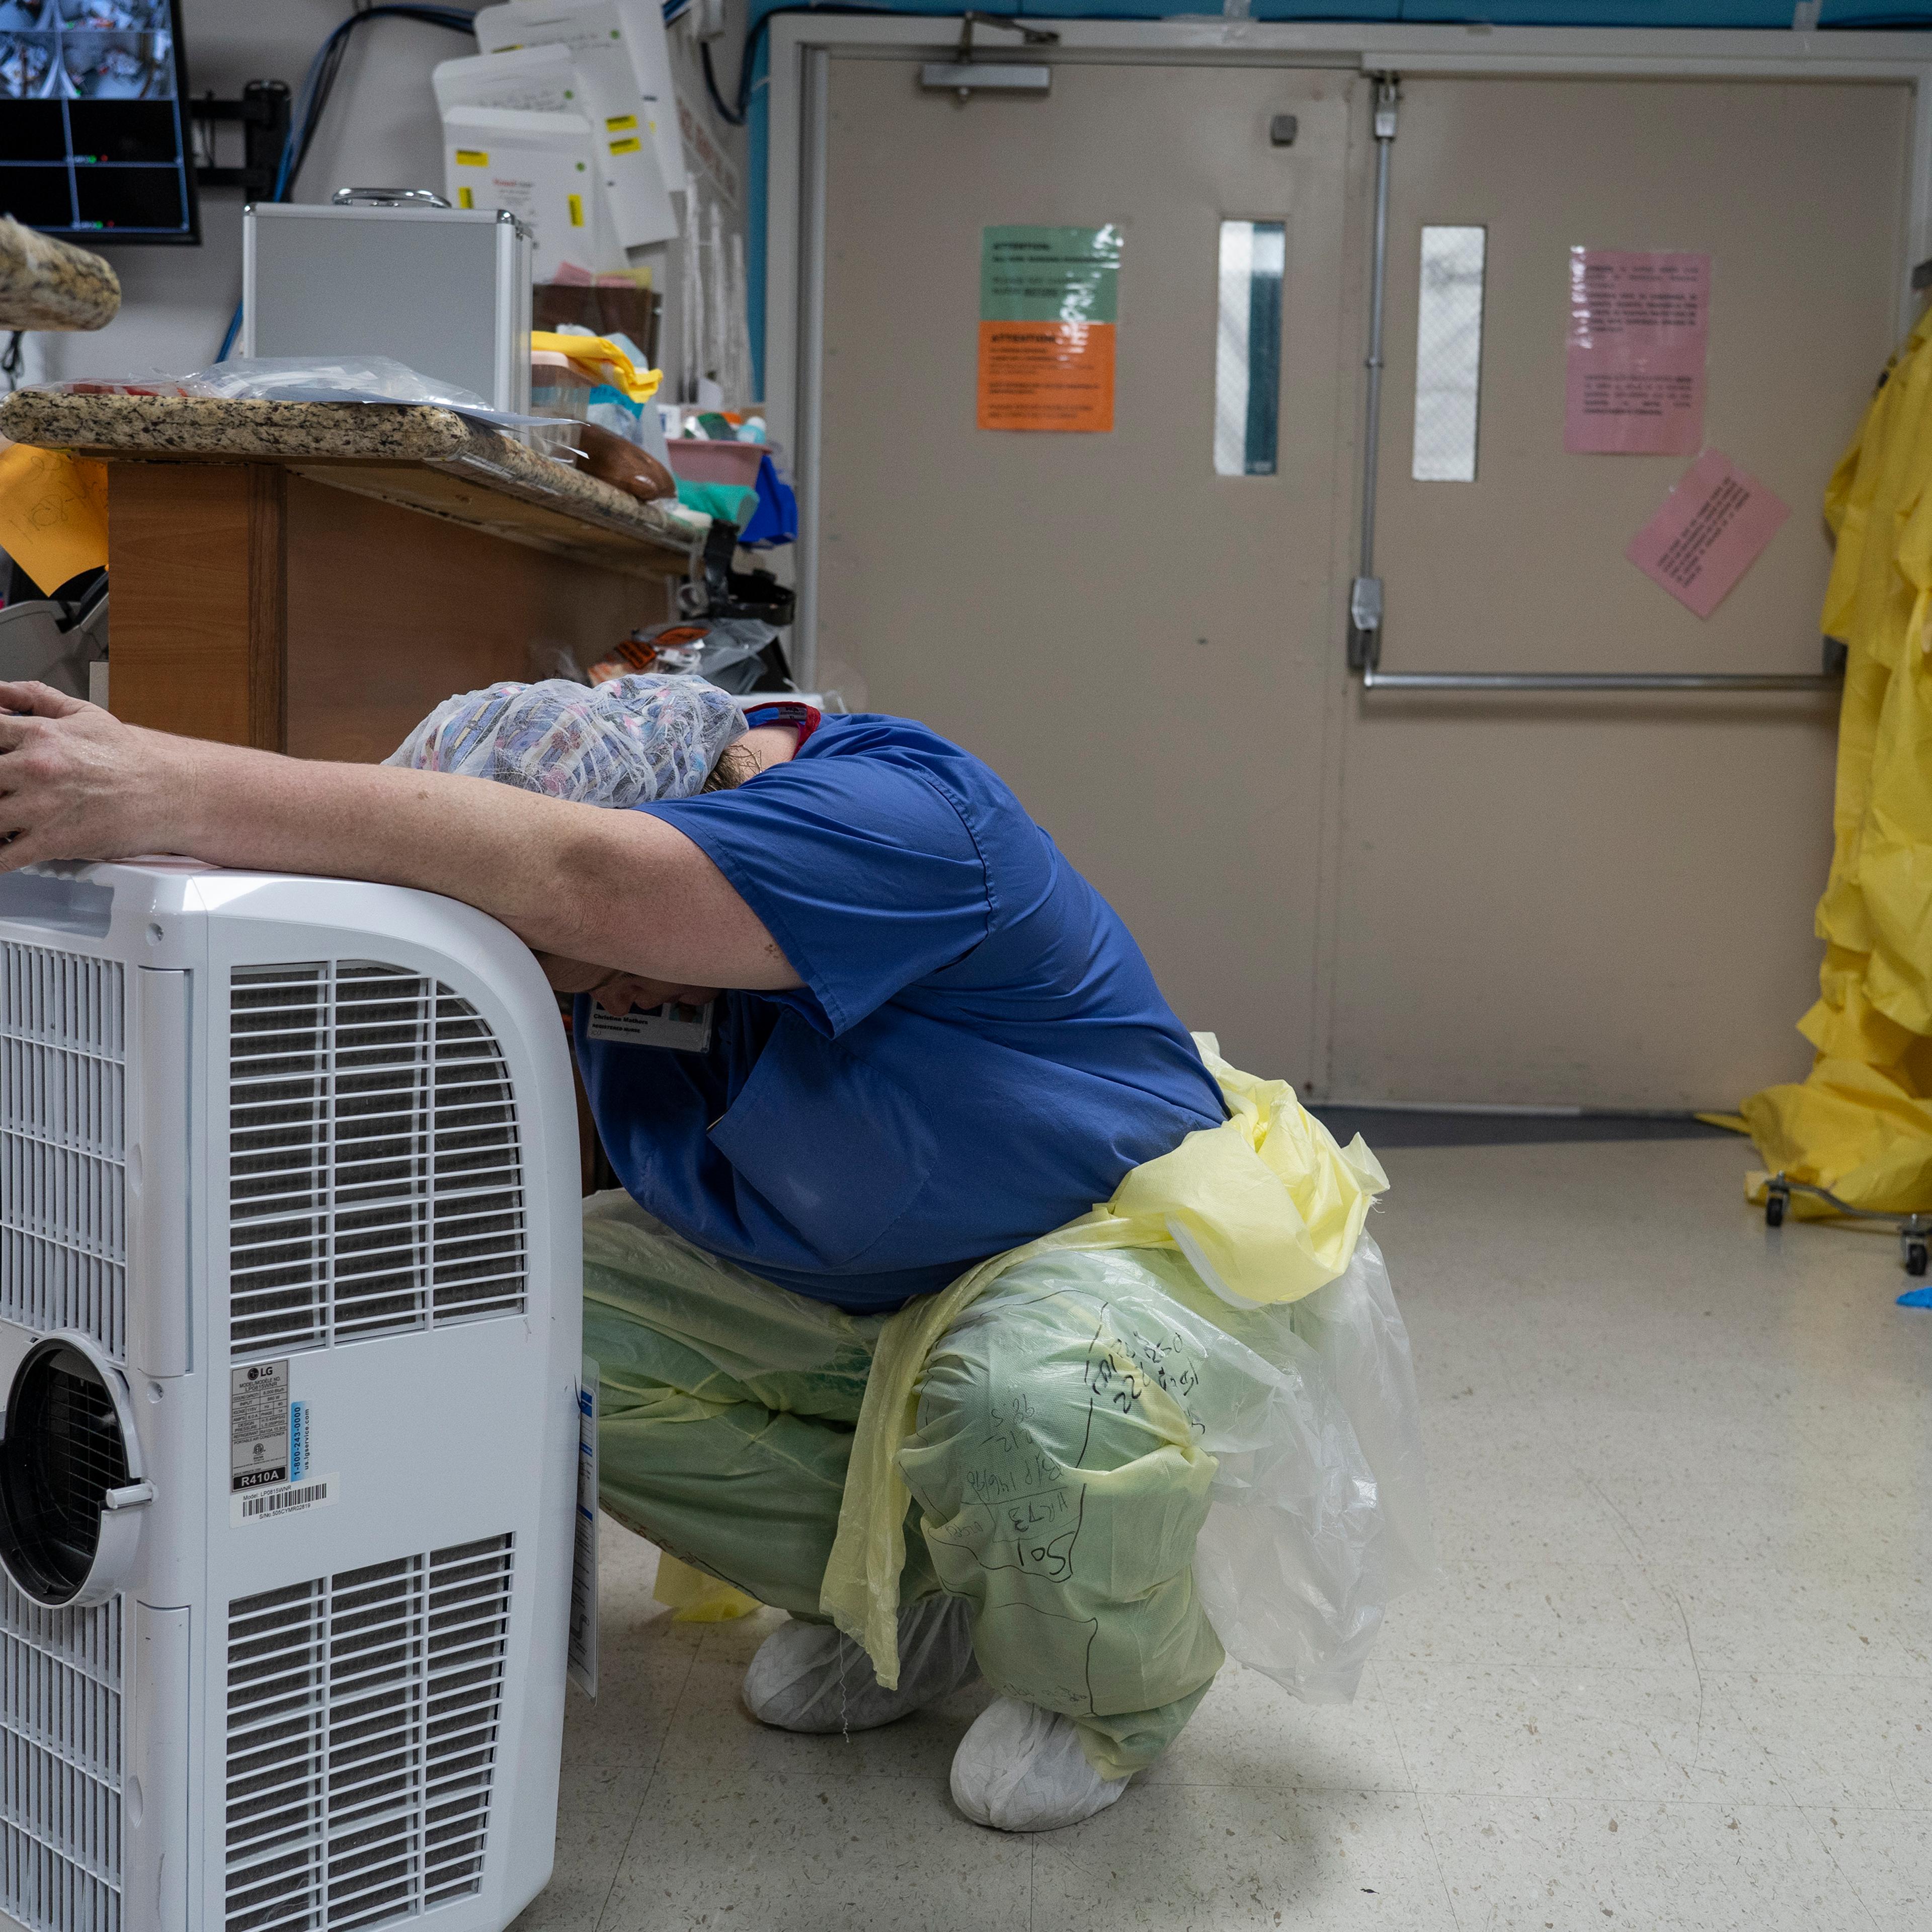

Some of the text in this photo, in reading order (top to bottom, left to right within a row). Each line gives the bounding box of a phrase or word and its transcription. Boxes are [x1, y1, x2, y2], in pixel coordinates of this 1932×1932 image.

[593, 1014, 621, 1022] Christina
[260, 1366, 273, 1377] LG
[234, 1424, 257, 1432] PRESSURE
[259, 1431, 285, 1440] CONDITIONER
[241, 1470, 279, 1486] R410A
[243, 1485, 292, 1501] Model: LP0815WNR
